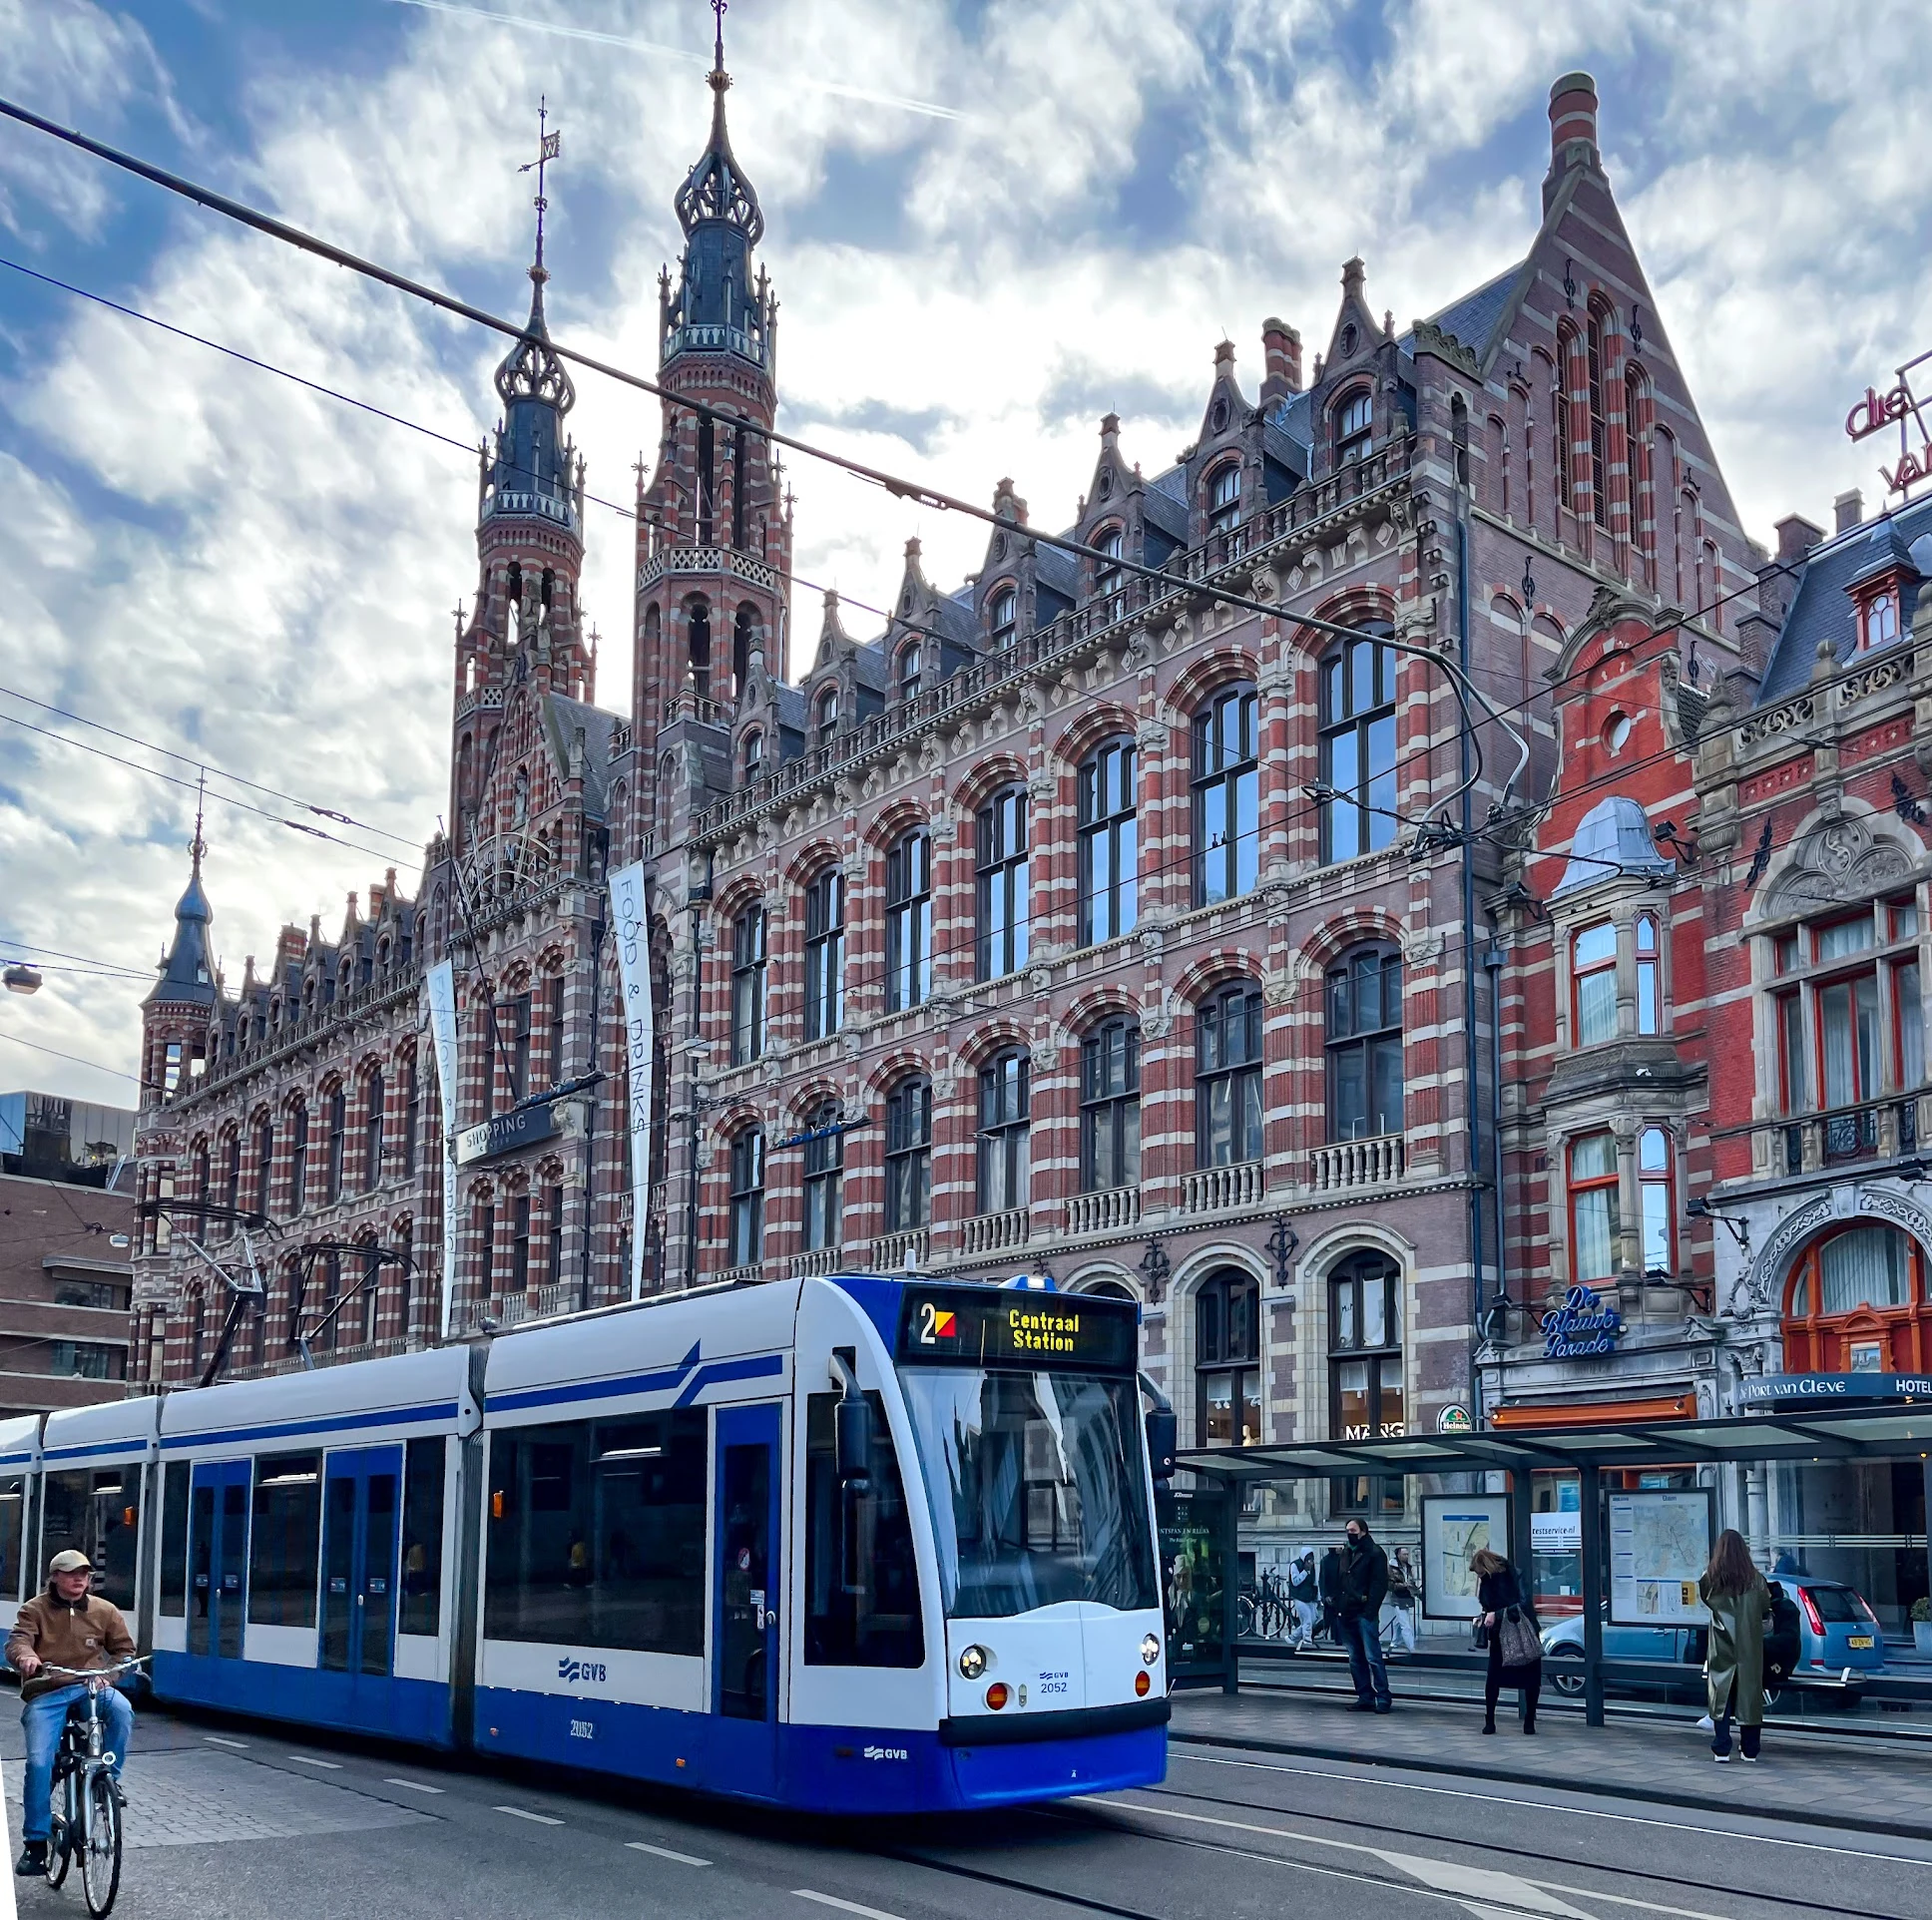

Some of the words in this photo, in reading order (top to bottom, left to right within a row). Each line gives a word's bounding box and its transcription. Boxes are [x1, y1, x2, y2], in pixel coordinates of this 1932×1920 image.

[622, 880, 637, 965] FOOD
[628, 984, 640, 1002] &
[435, 975, 451, 1081] FASHION
[631, 1019, 645, 1134] DRINKS
[467, 1115, 526, 1148] SHOPPING
[1561, 1285, 1600, 1310] De
[920, 1302, 936, 1344] 2
[1009, 1309, 1080, 1332] Centraal
[1538, 1304, 1617, 1335] Blauwe
[1013, 1329, 1074, 1351] Station
[1542, 1331, 1611, 1357] Parade
[1774, 1382, 1797, 1395] van
[1896, 1379, 1932, 1393] HOTEL
[582, 1663, 607, 1682] GVB
[1041, 1682, 1068, 1693] 2052
[571, 1718, 593, 1739] 2052
[884, 1748, 907, 1759] GVB
